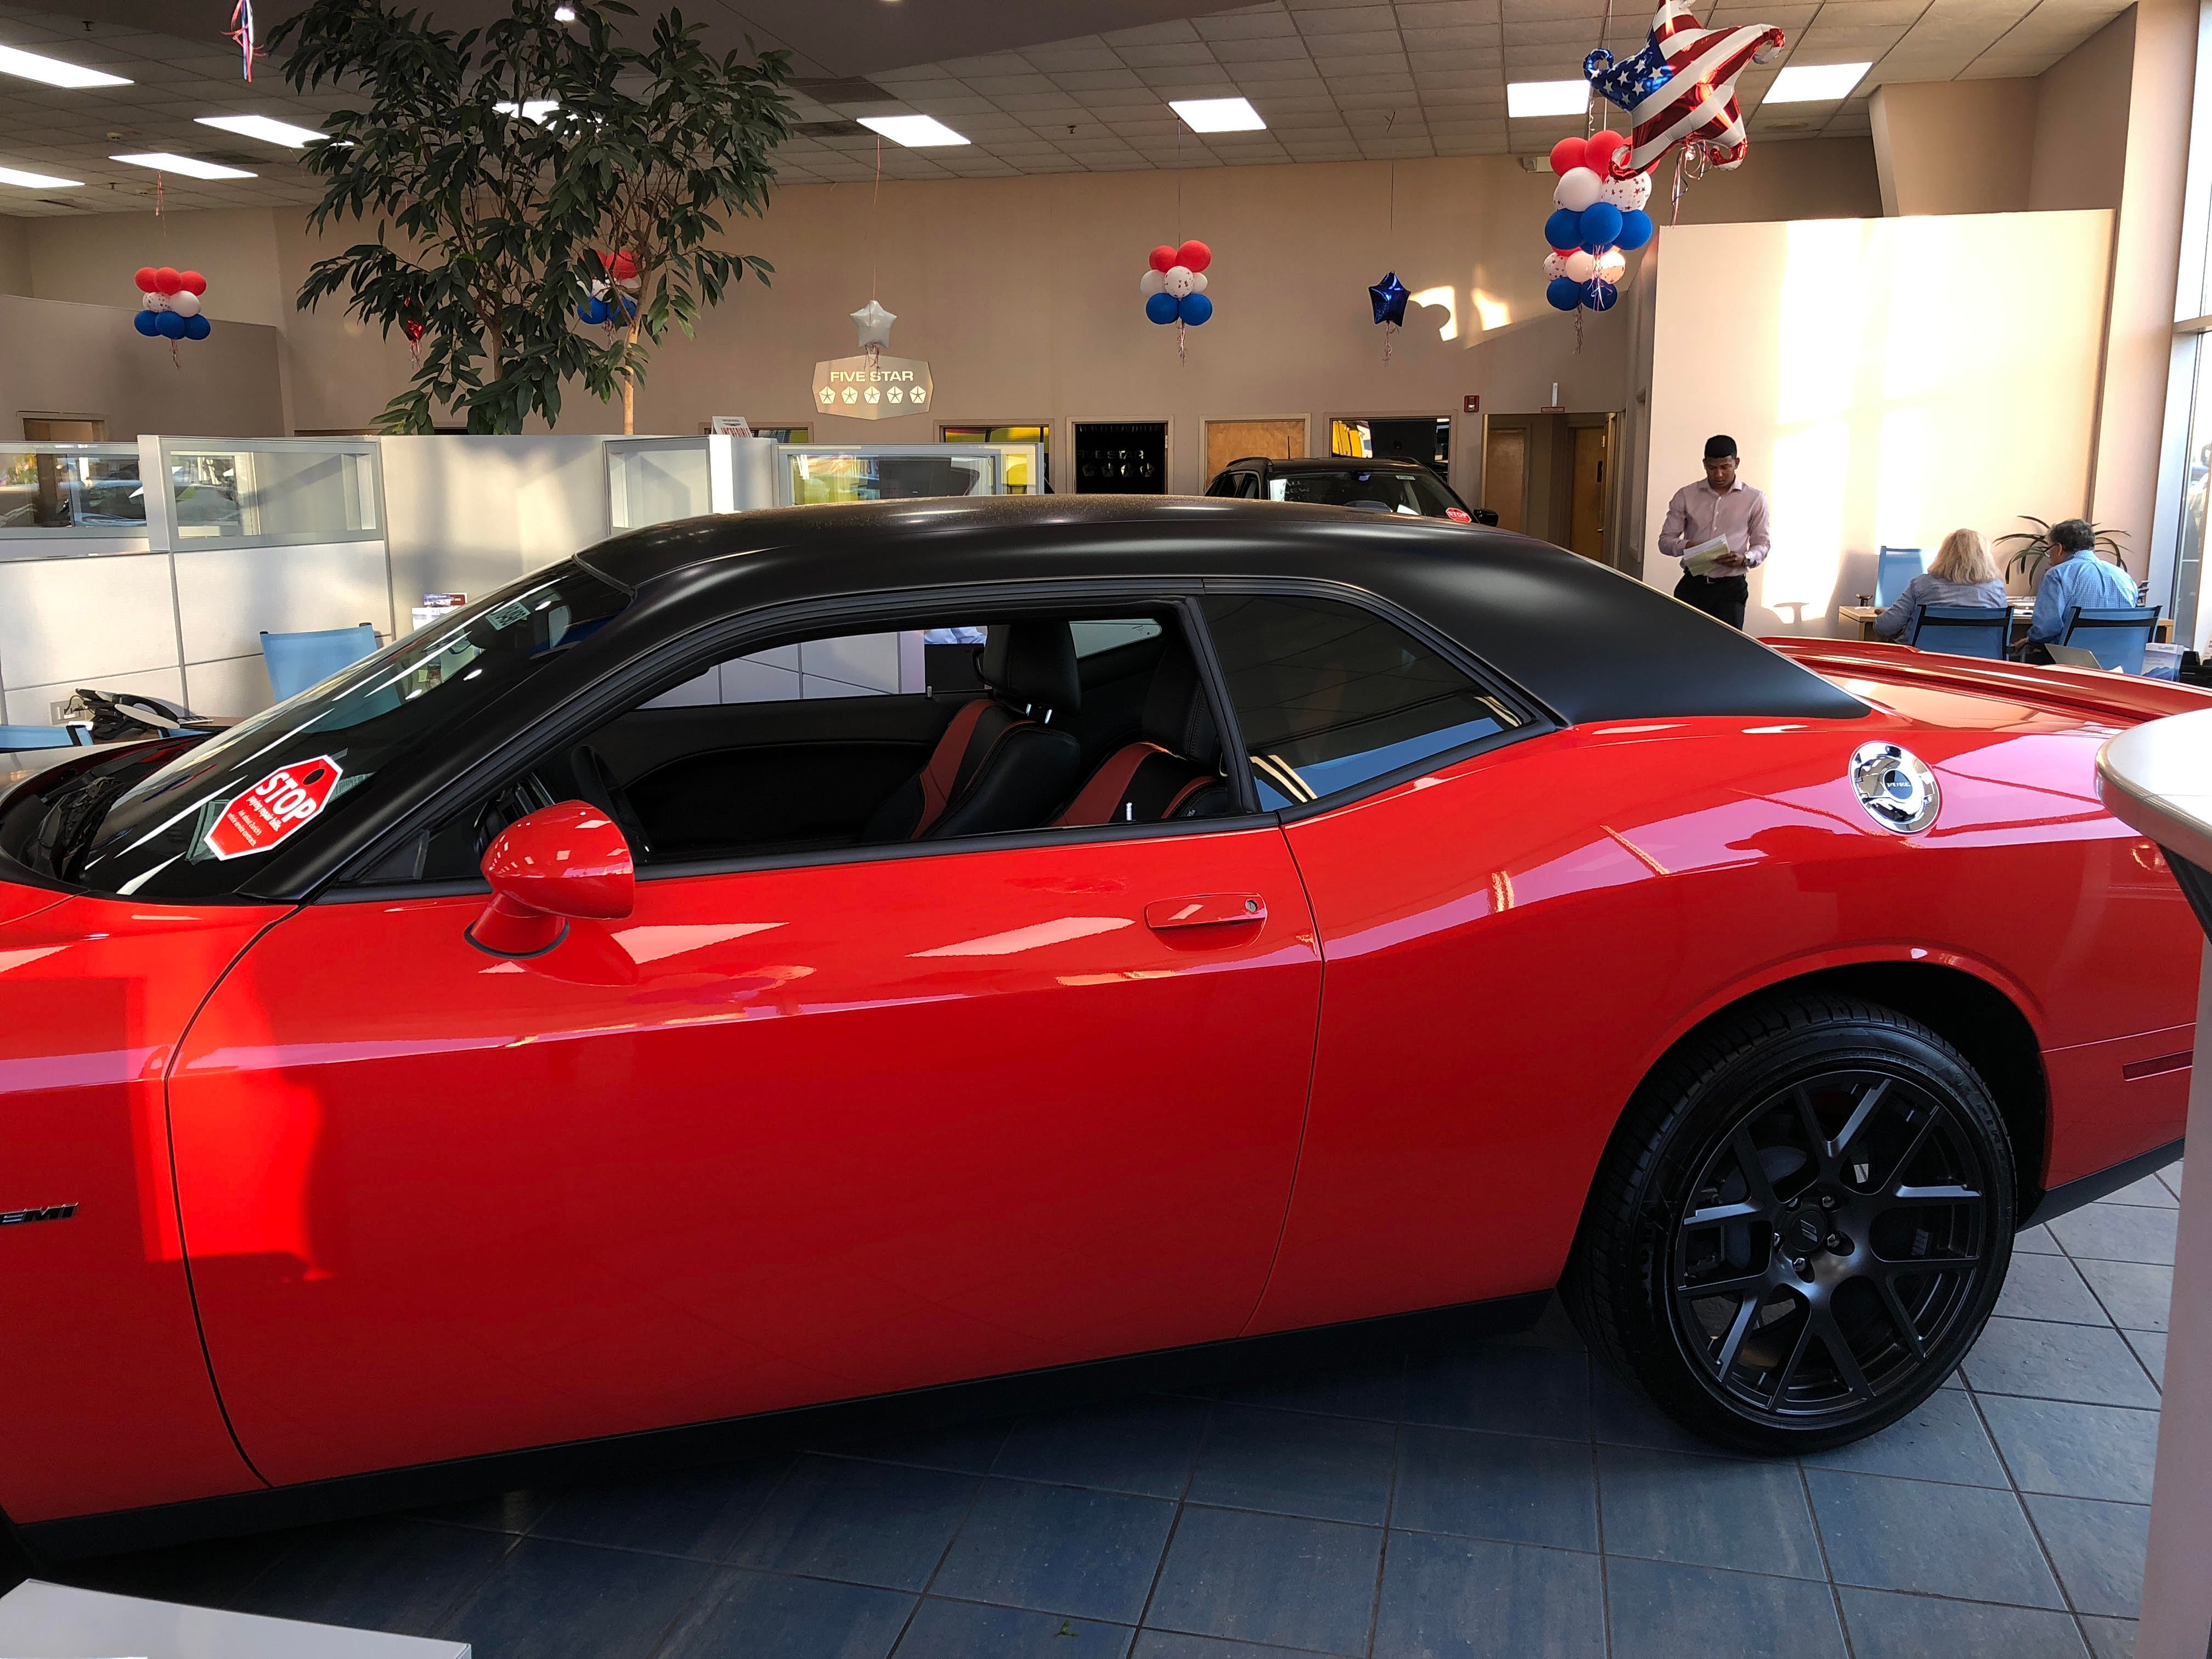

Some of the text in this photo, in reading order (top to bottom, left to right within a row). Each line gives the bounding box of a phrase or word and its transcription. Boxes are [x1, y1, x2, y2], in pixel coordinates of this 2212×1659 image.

[830, 371, 914, 382] FIVE STAR
[255, 771, 317, 823] STOP
[238, 809, 246, 817] Ask
[241, 814, 253, 826] about
[246, 795, 282, 832] paying repair bills.
[227, 812, 238, 824] vehicle
[234, 821, 246, 833] service
